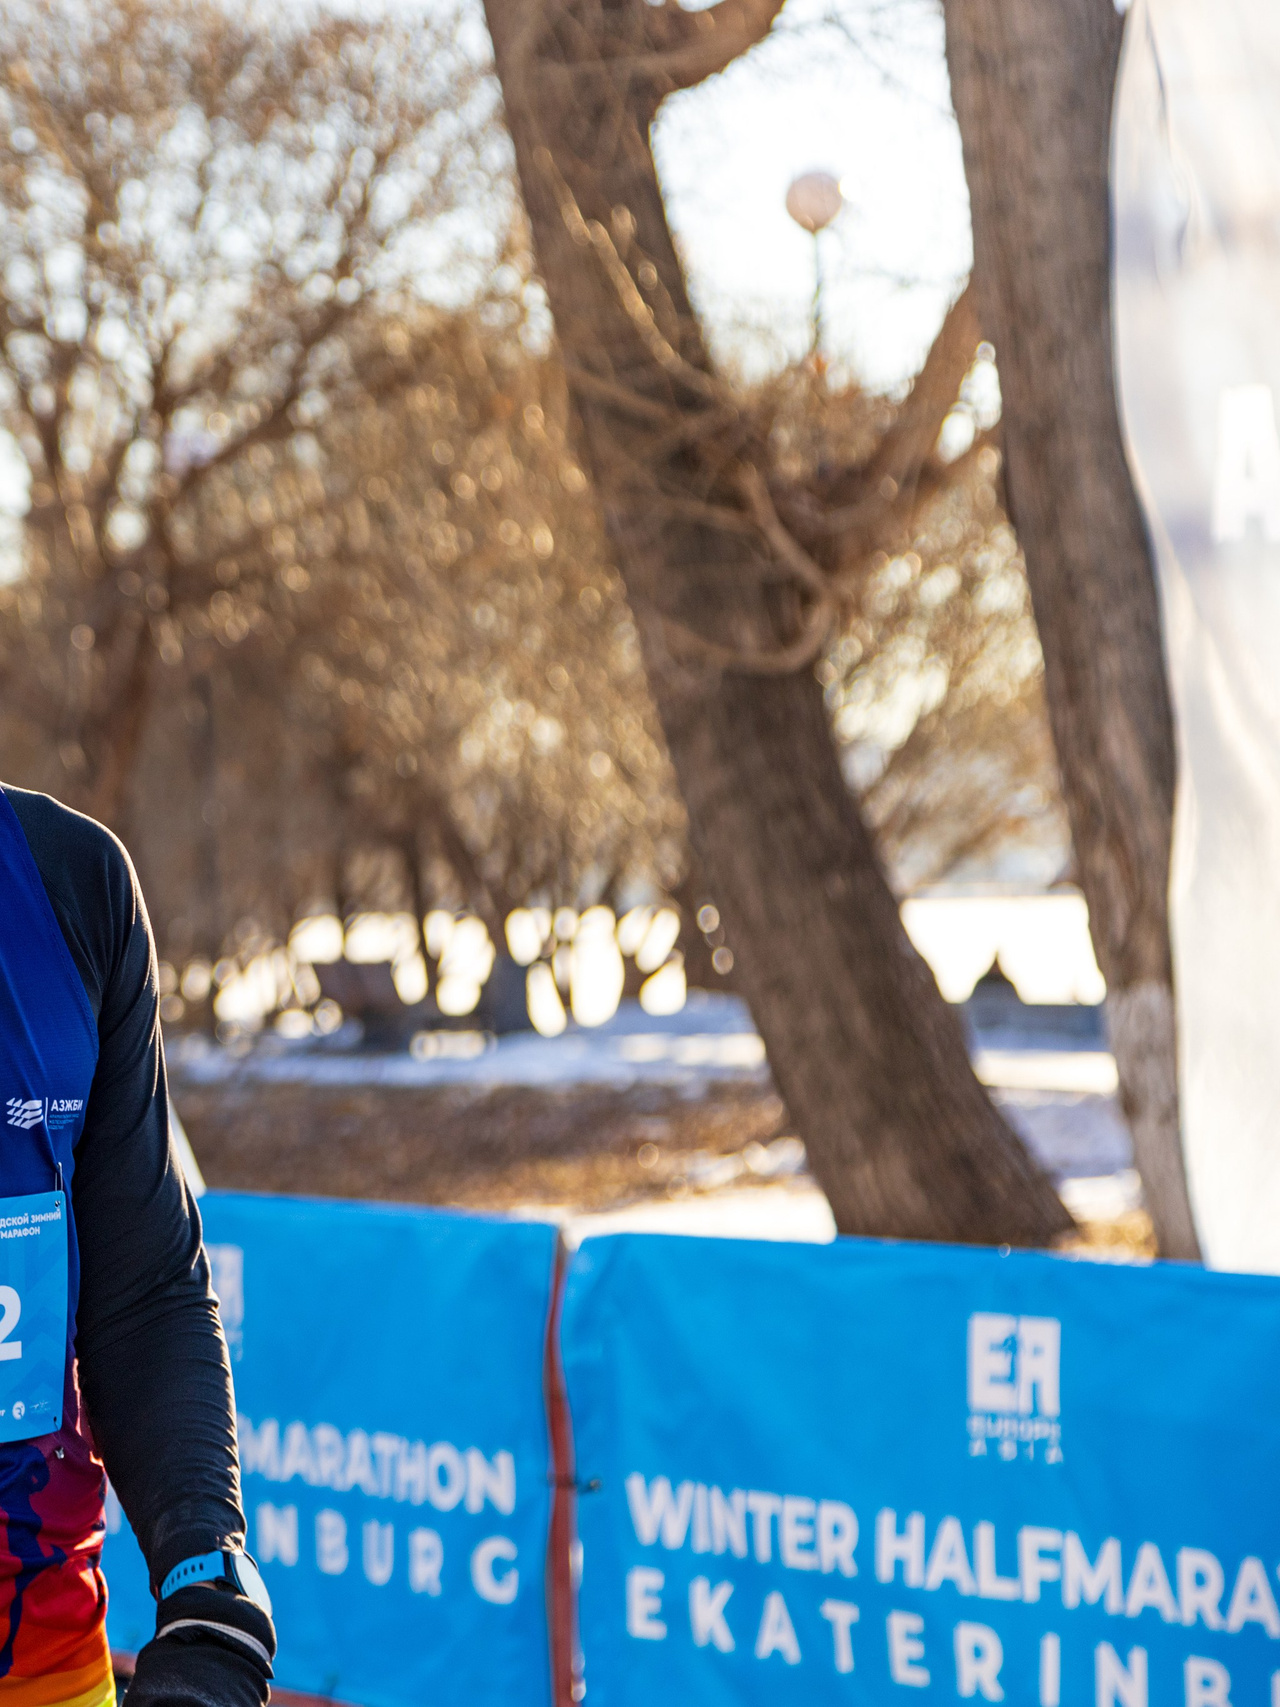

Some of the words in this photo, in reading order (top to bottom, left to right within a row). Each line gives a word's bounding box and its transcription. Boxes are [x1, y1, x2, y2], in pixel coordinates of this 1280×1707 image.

[50, 1099, 84, 1112] АЗЖБИ
[30, 1208, 62, 1225] ЗИМНИЙ
[625, 1471, 860, 1580] WINTER
[874, 1506, 1280, 1640] HALFMARA
[625, 1564, 1280, 1707] EKATERINB
